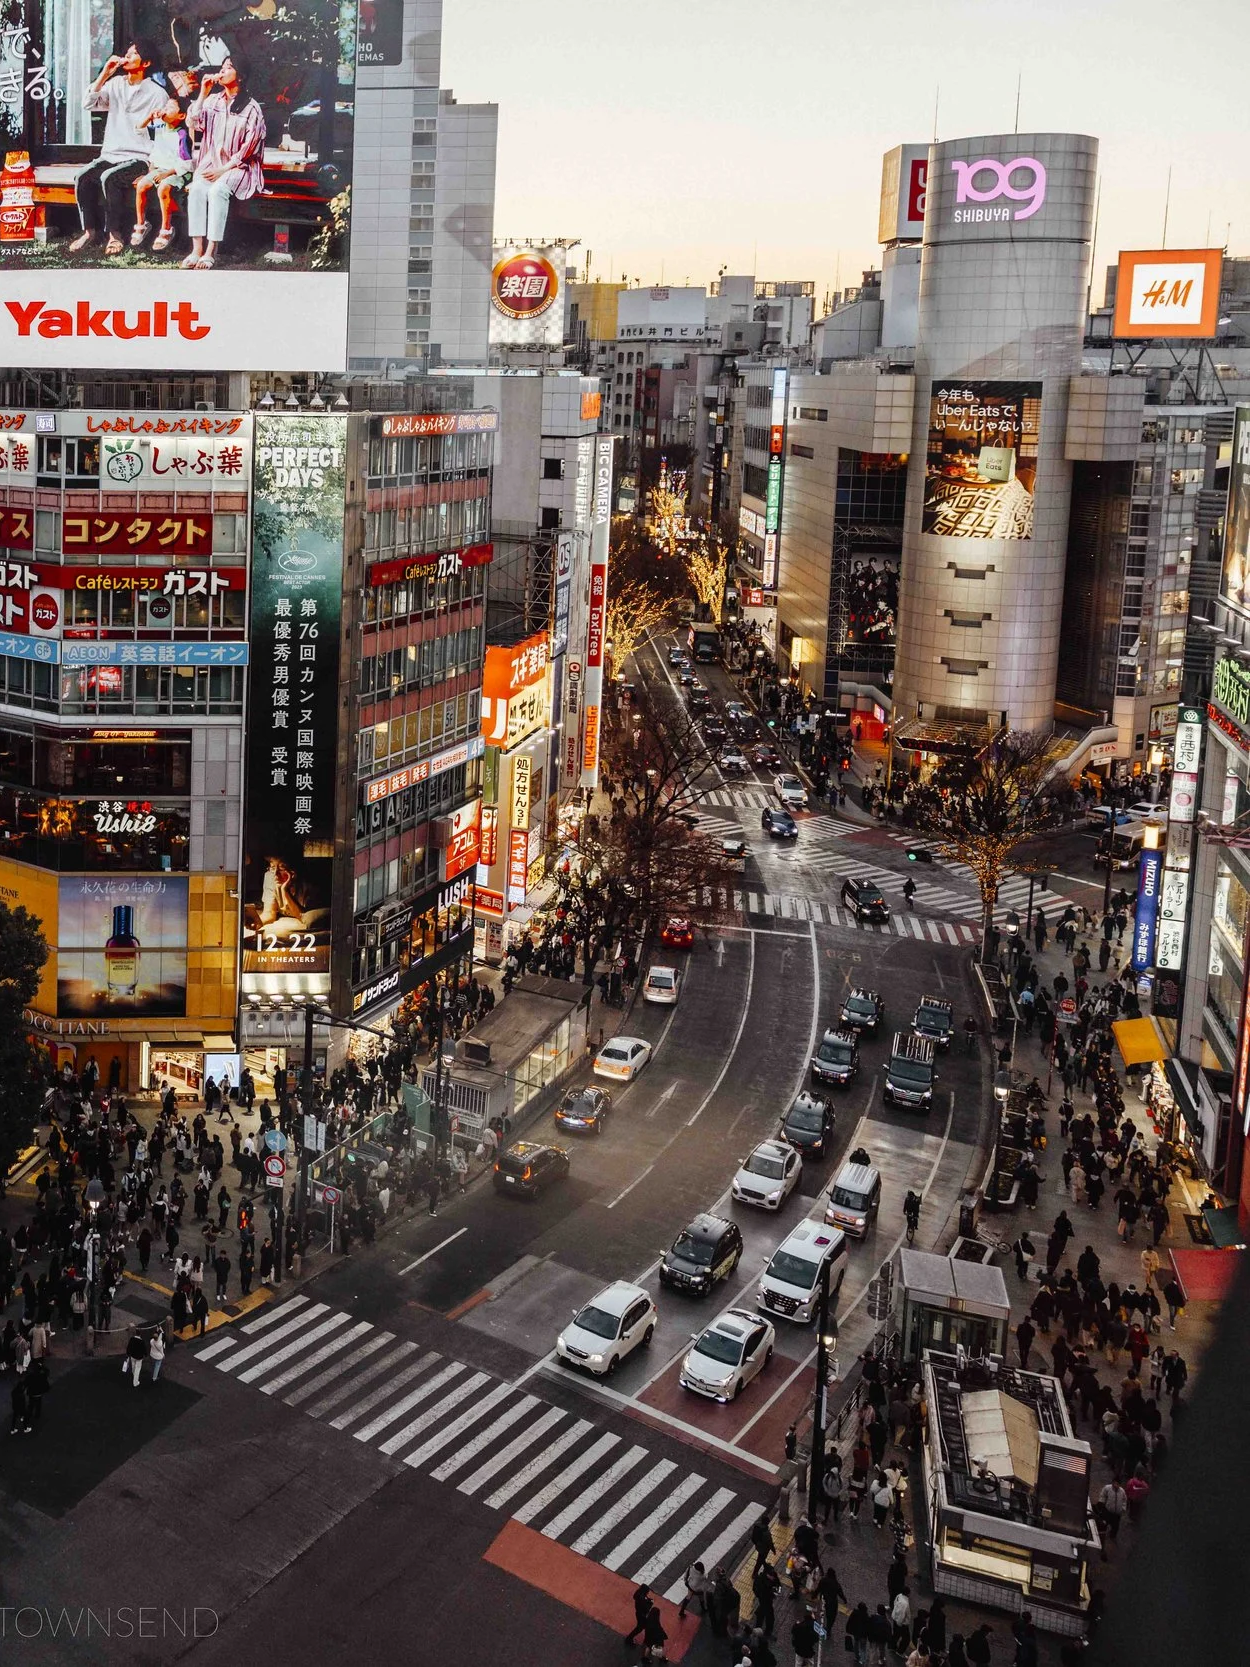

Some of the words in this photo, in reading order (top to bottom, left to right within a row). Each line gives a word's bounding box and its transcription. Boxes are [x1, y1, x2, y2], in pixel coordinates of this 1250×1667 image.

[358, 43, 373, 52] HO
[359, 53, 384, 61] EMAS
[951, 157, 1047, 221] 109
[954, 208, 1009, 223] SHIBUYA
[500, 275, 548, 298] 楽園
[1142, 279, 1193, 308] H&M
[491, 296, 516, 319] EXCITING
[517, 296, 554, 319] AMUSEMENT
[4, 300, 211, 341] Yakult
[648, 327, 704, 336] 井門ビル
[937, 388, 981, 402] 今年も、
[936, 404, 968, 416] Uber
[970, 404, 1000, 417] Eats
[87, 415, 244, 435] しゃぶしゃぶバイキング
[152, 445, 243, 476] しゃぶ葉
[259, 447, 342, 468] PERFECT
[599, 443, 611, 464] BIC
[275, 468, 324, 488] DAYS
[596, 468, 611, 525] CAMERA
[64, 517, 207, 546] コンタクト
[437, 554, 462, 577] ガスト
[76, 575, 158, 590] Caféレストラン
[163, 569, 230, 596] ガスト
[35, 609, 56, 620] ガスト
[589, 604, 603, 656] TaxFree
[68, 646, 110, 660] AEON
[121, 644, 244, 663] 英会話イーオン
[271, 599, 292, 728] 最優秀男優賞
[510, 642, 548, 689] スギ薬局
[294, 599, 319, 834] 第76回カンヌ国際映画祭
[471, 739, 484, 757] 4F
[270, 746, 289, 786] 受賞
[516, 758, 529, 826] 処方せん3F
[98, 801, 124, 813] 渋谷
[93, 813, 157, 833] Ushi8
[453, 831, 474, 855] アコム
[482, 832, 490, 854] アコム
[459, 858, 467, 870] 3F
[512, 834, 526, 885] スギ薬局
[80, 881, 167, 894] 永久花の生命力
[1145, 859, 1157, 896] MIZUHO
[438, 876, 469, 913] LUSH
[1176, 881, 1184, 906] フルーツ
[256, 934, 317, 953] 12.22
[367, 971, 399, 1001] サンドラッグ
[22, 1008, 110, 1036] OCCITANE
